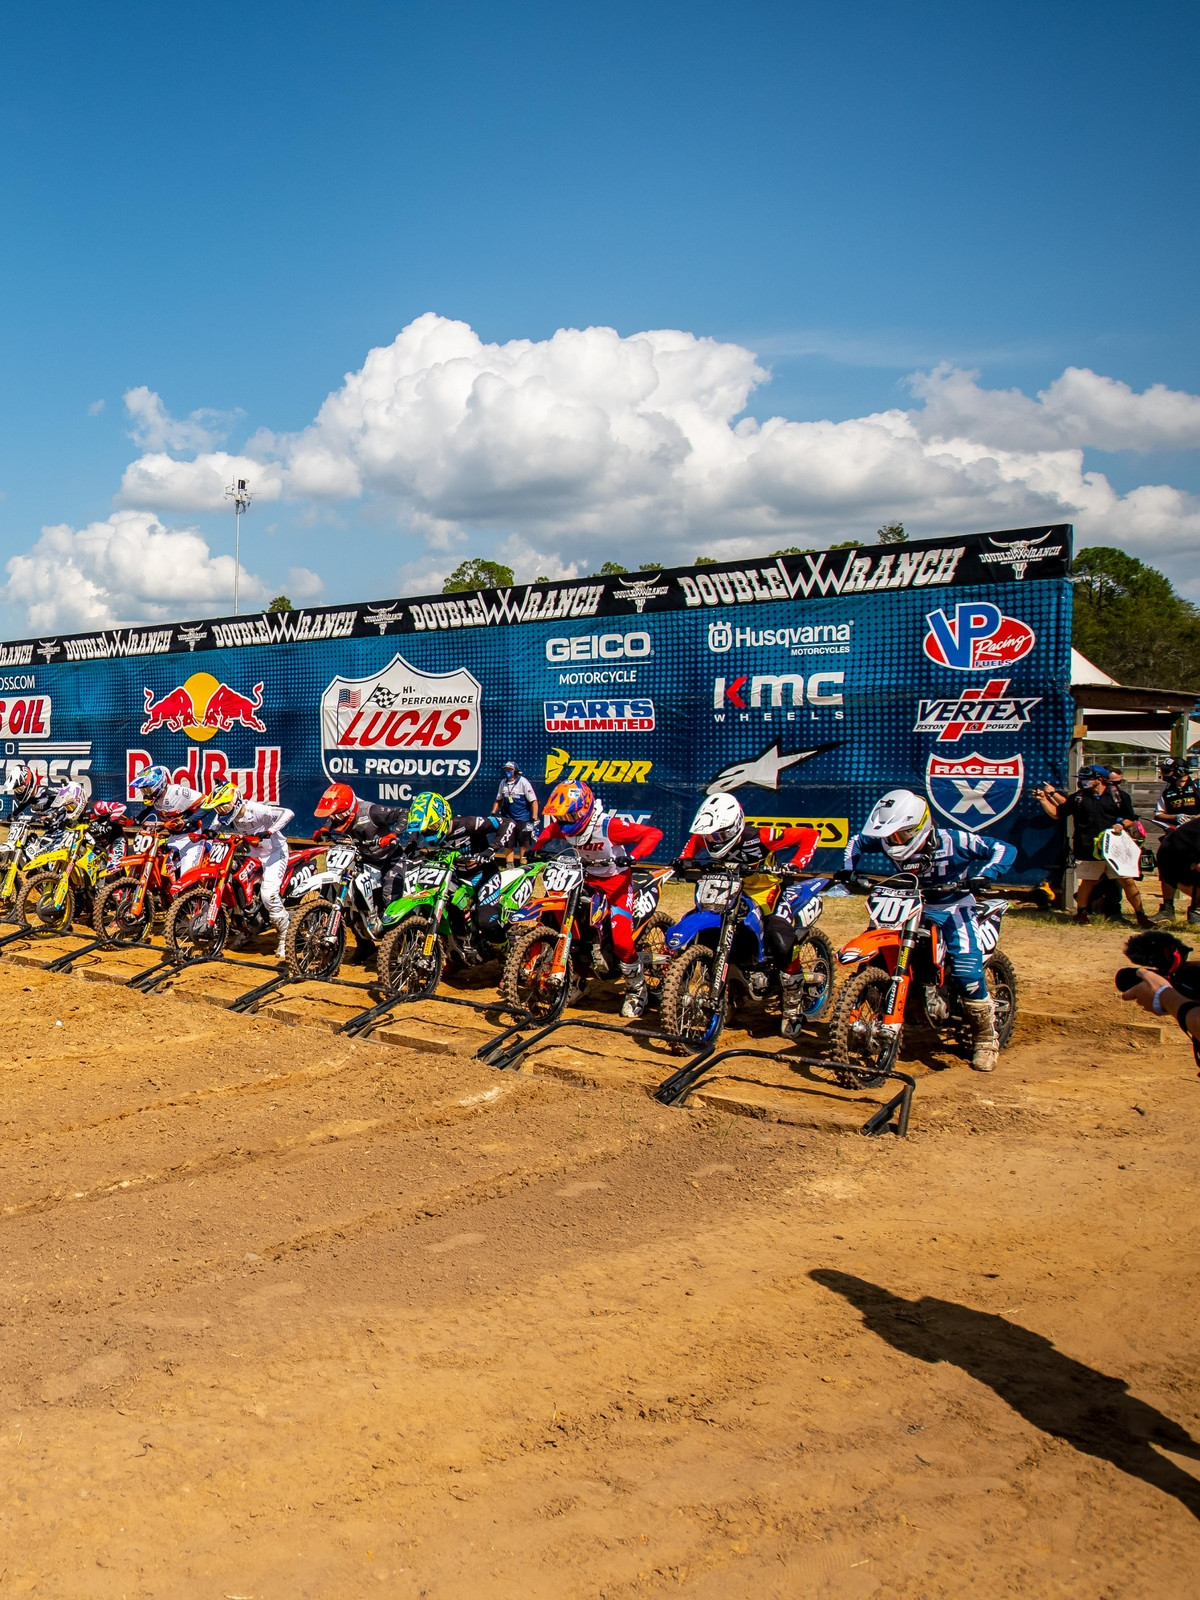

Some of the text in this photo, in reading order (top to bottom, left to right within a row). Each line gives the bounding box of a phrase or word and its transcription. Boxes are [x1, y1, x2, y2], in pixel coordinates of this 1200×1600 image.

[545, 631, 651, 662] GEICO
[735, 622, 850, 650] Husqvarna
[926, 602, 1002, 669] VP
[975, 634, 1032, 660] Racing
[791, 645, 850, 656] MOTORCYCLES
[974, 659, 1012, 668] FUELS
[559, 670, 637, 685] MOTORCYCLE
[401, 695, 473, 705] PERFORMANCE
[545, 698, 653, 719] PARTS
[918, 699, 1032, 722] VERTEX
[9, 699, 45, 733] OIL
[338, 708, 470, 747] LUCAS
[546, 717, 654, 732] UNLIMITED
[714, 711, 844, 723] WHEELS
[984, 723, 1019, 731] POWER
[329, 757, 471, 776] OIL PRODUCTS
[568, 760, 653, 783] THOR
[934, 765, 1014, 775] RACER
[950, 780, 996, 815] X
[418, 867, 447, 885] 221
[544, 868, 580, 892] 387
[515, 877, 533, 909] 221
[798, 897, 822, 927] 162
[870, 897, 915, 921] 701
[979, 920, 1000, 951] 01
